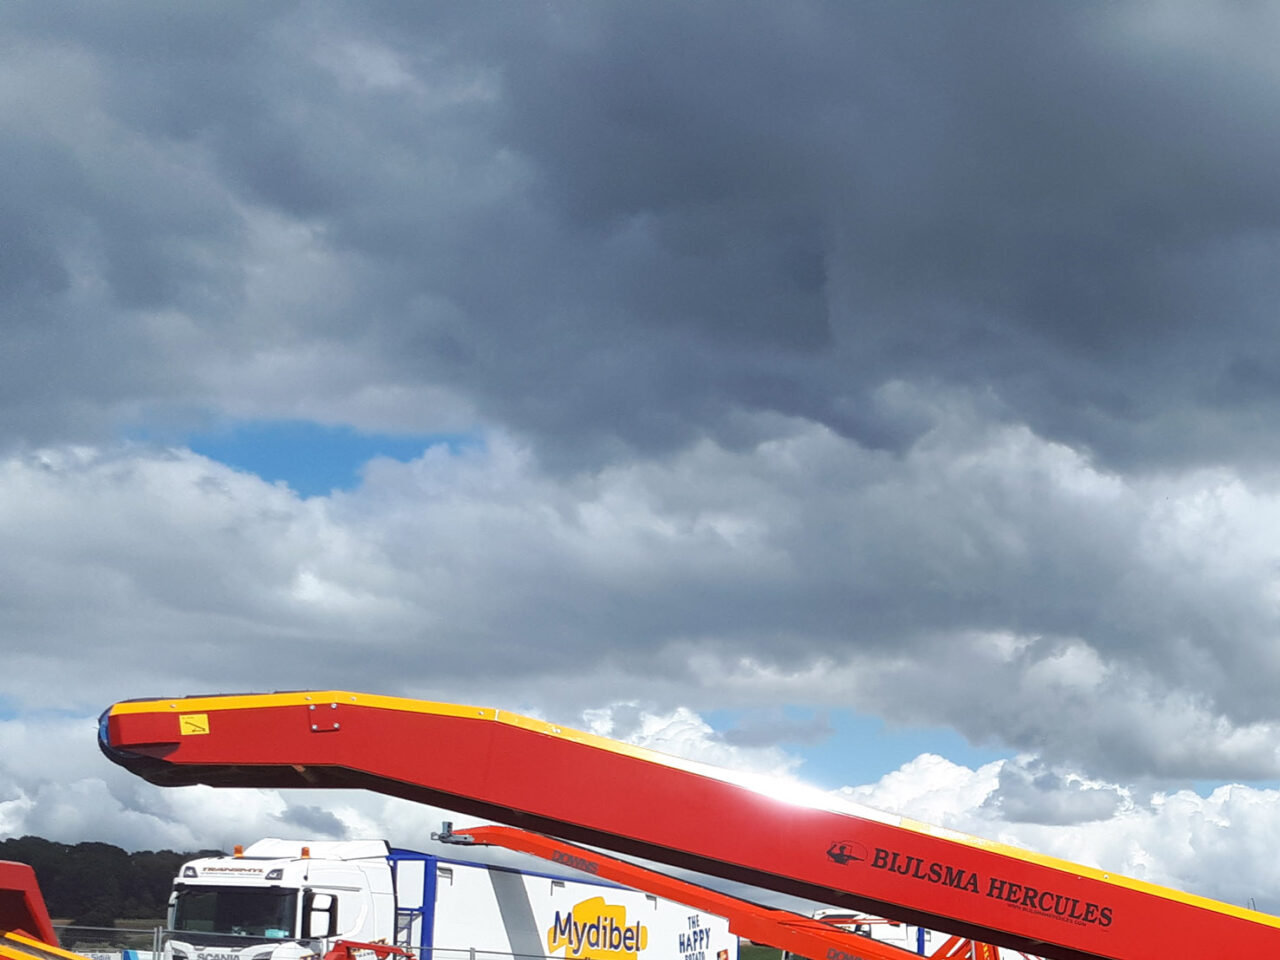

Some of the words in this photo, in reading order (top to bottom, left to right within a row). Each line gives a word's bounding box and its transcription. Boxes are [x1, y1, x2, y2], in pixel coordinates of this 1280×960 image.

[552, 850, 599, 874] DOWNS
[871, 848, 980, 894] BIJLSMA
[986, 877, 1113, 927] HERCULES
[553, 911, 641, 955] Mydibel
[687, 914, 700, 930] THE
[679, 927, 711, 954] HAPPY
